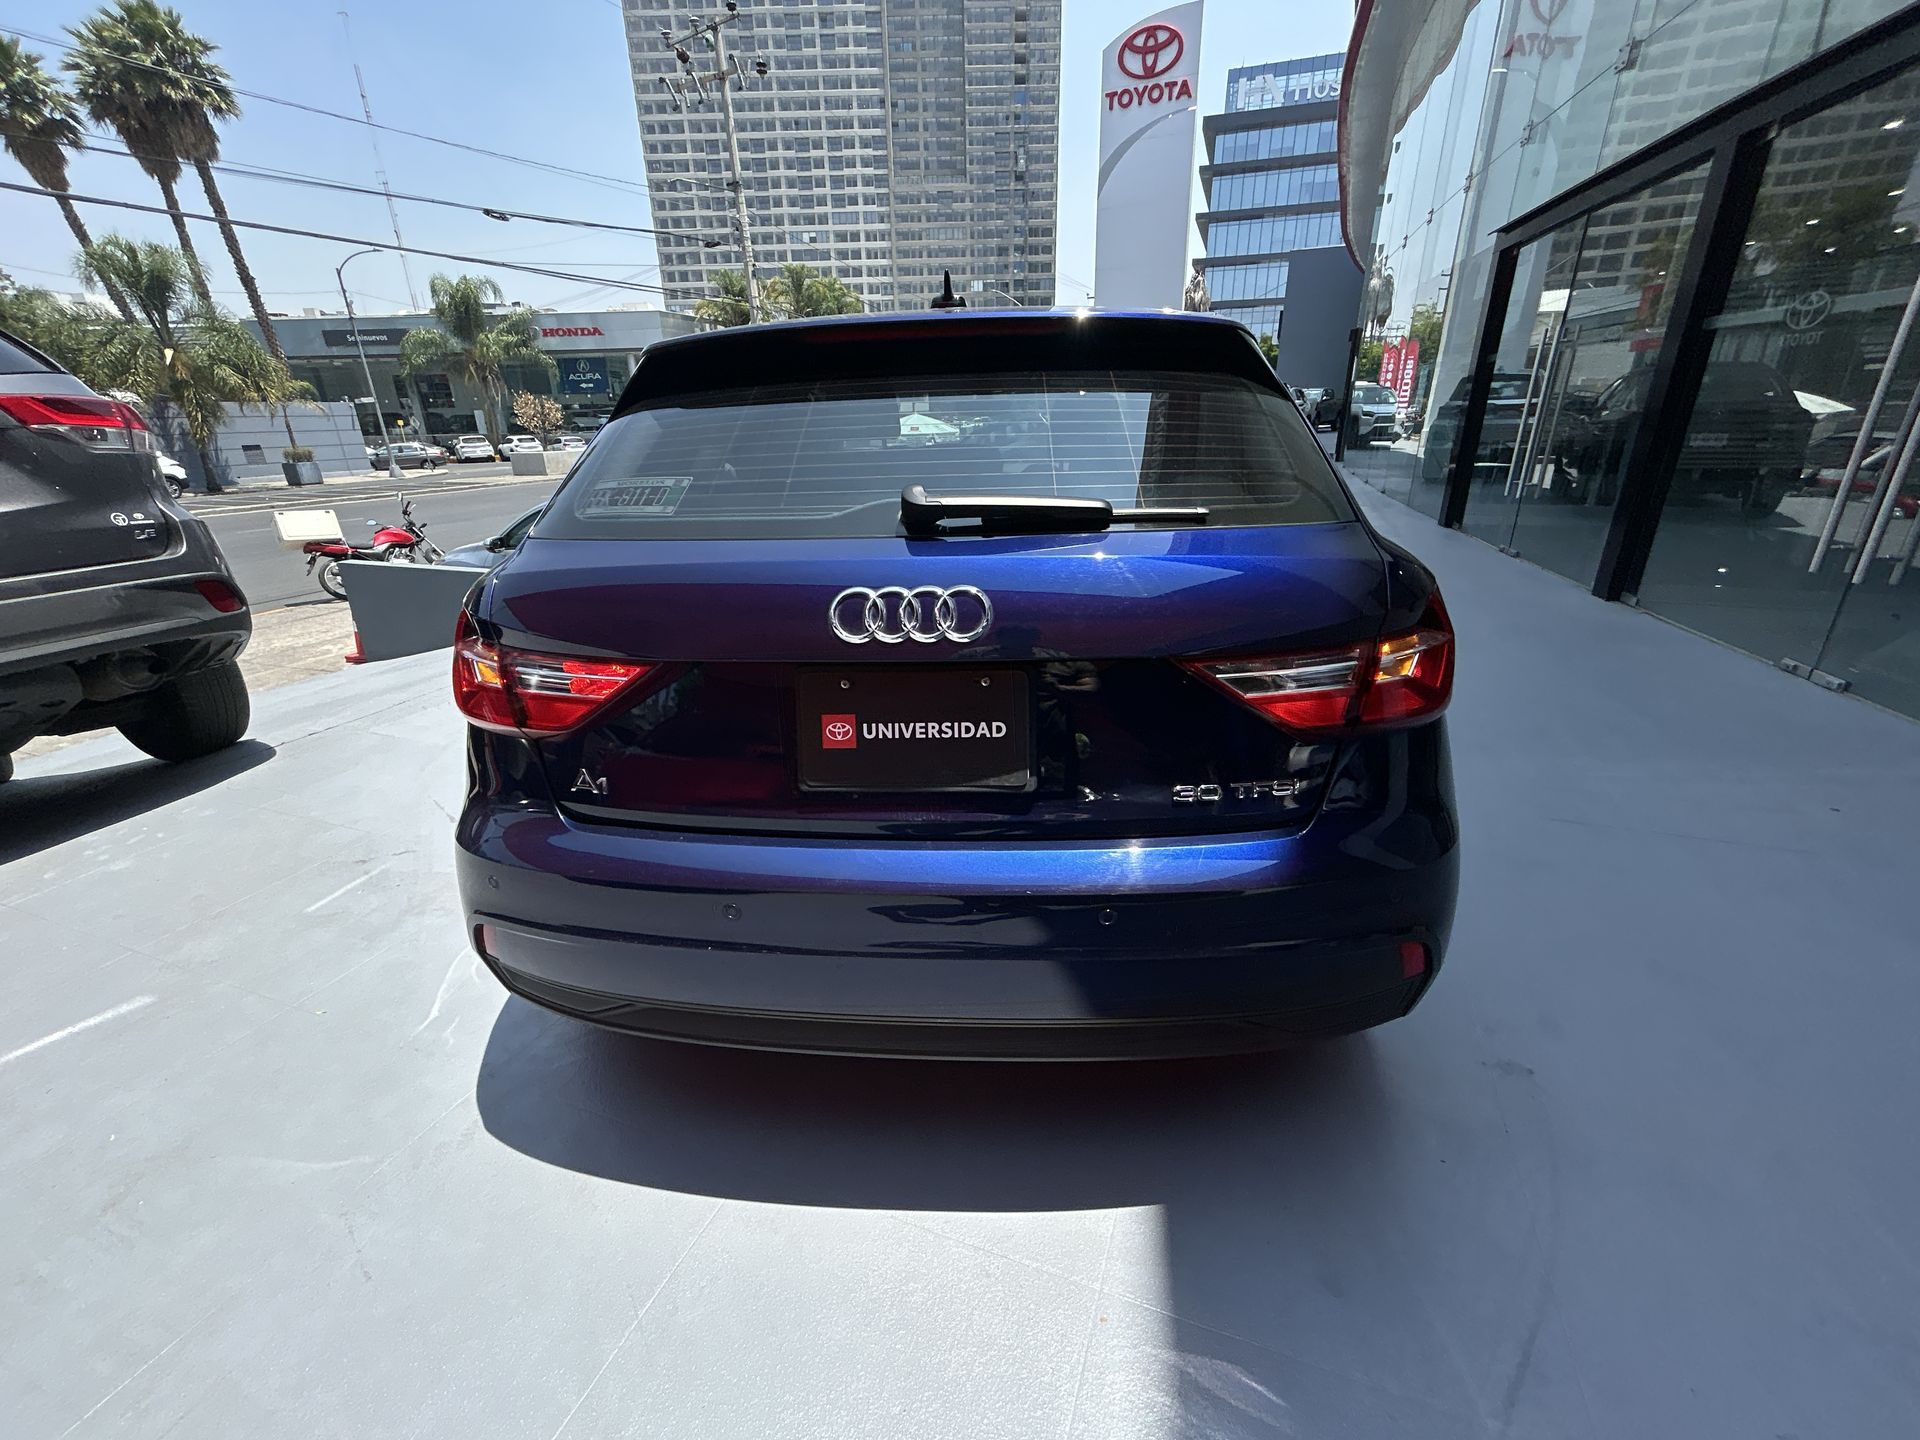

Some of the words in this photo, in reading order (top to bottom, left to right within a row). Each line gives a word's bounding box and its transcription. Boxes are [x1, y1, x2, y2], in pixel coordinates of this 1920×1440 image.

[1105, 79, 1192, 111] TOYOTA
[541, 327, 605, 337] HONDA
[862, 722, 1007, 740] UNIVERSIDAD
[570, 768, 608, 795] A1
[1173, 784, 1222, 801] 30
[1230, 779, 1300, 799] TFSI
